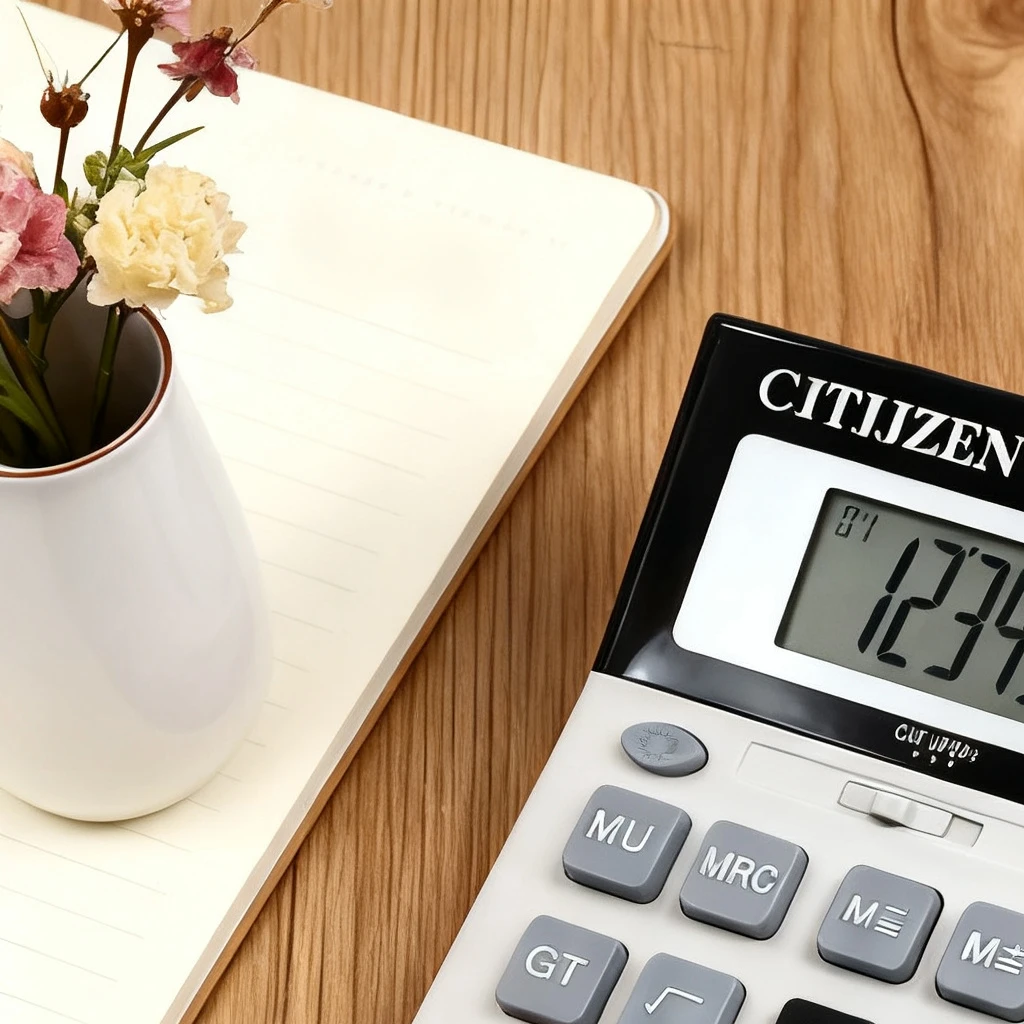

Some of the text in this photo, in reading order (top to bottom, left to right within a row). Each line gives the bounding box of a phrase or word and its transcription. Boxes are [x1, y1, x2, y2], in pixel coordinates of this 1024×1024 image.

[585, 808, 655, 853] MU
[698, 845, 779, 895] MRC
[524, 945, 590, 987] GT
